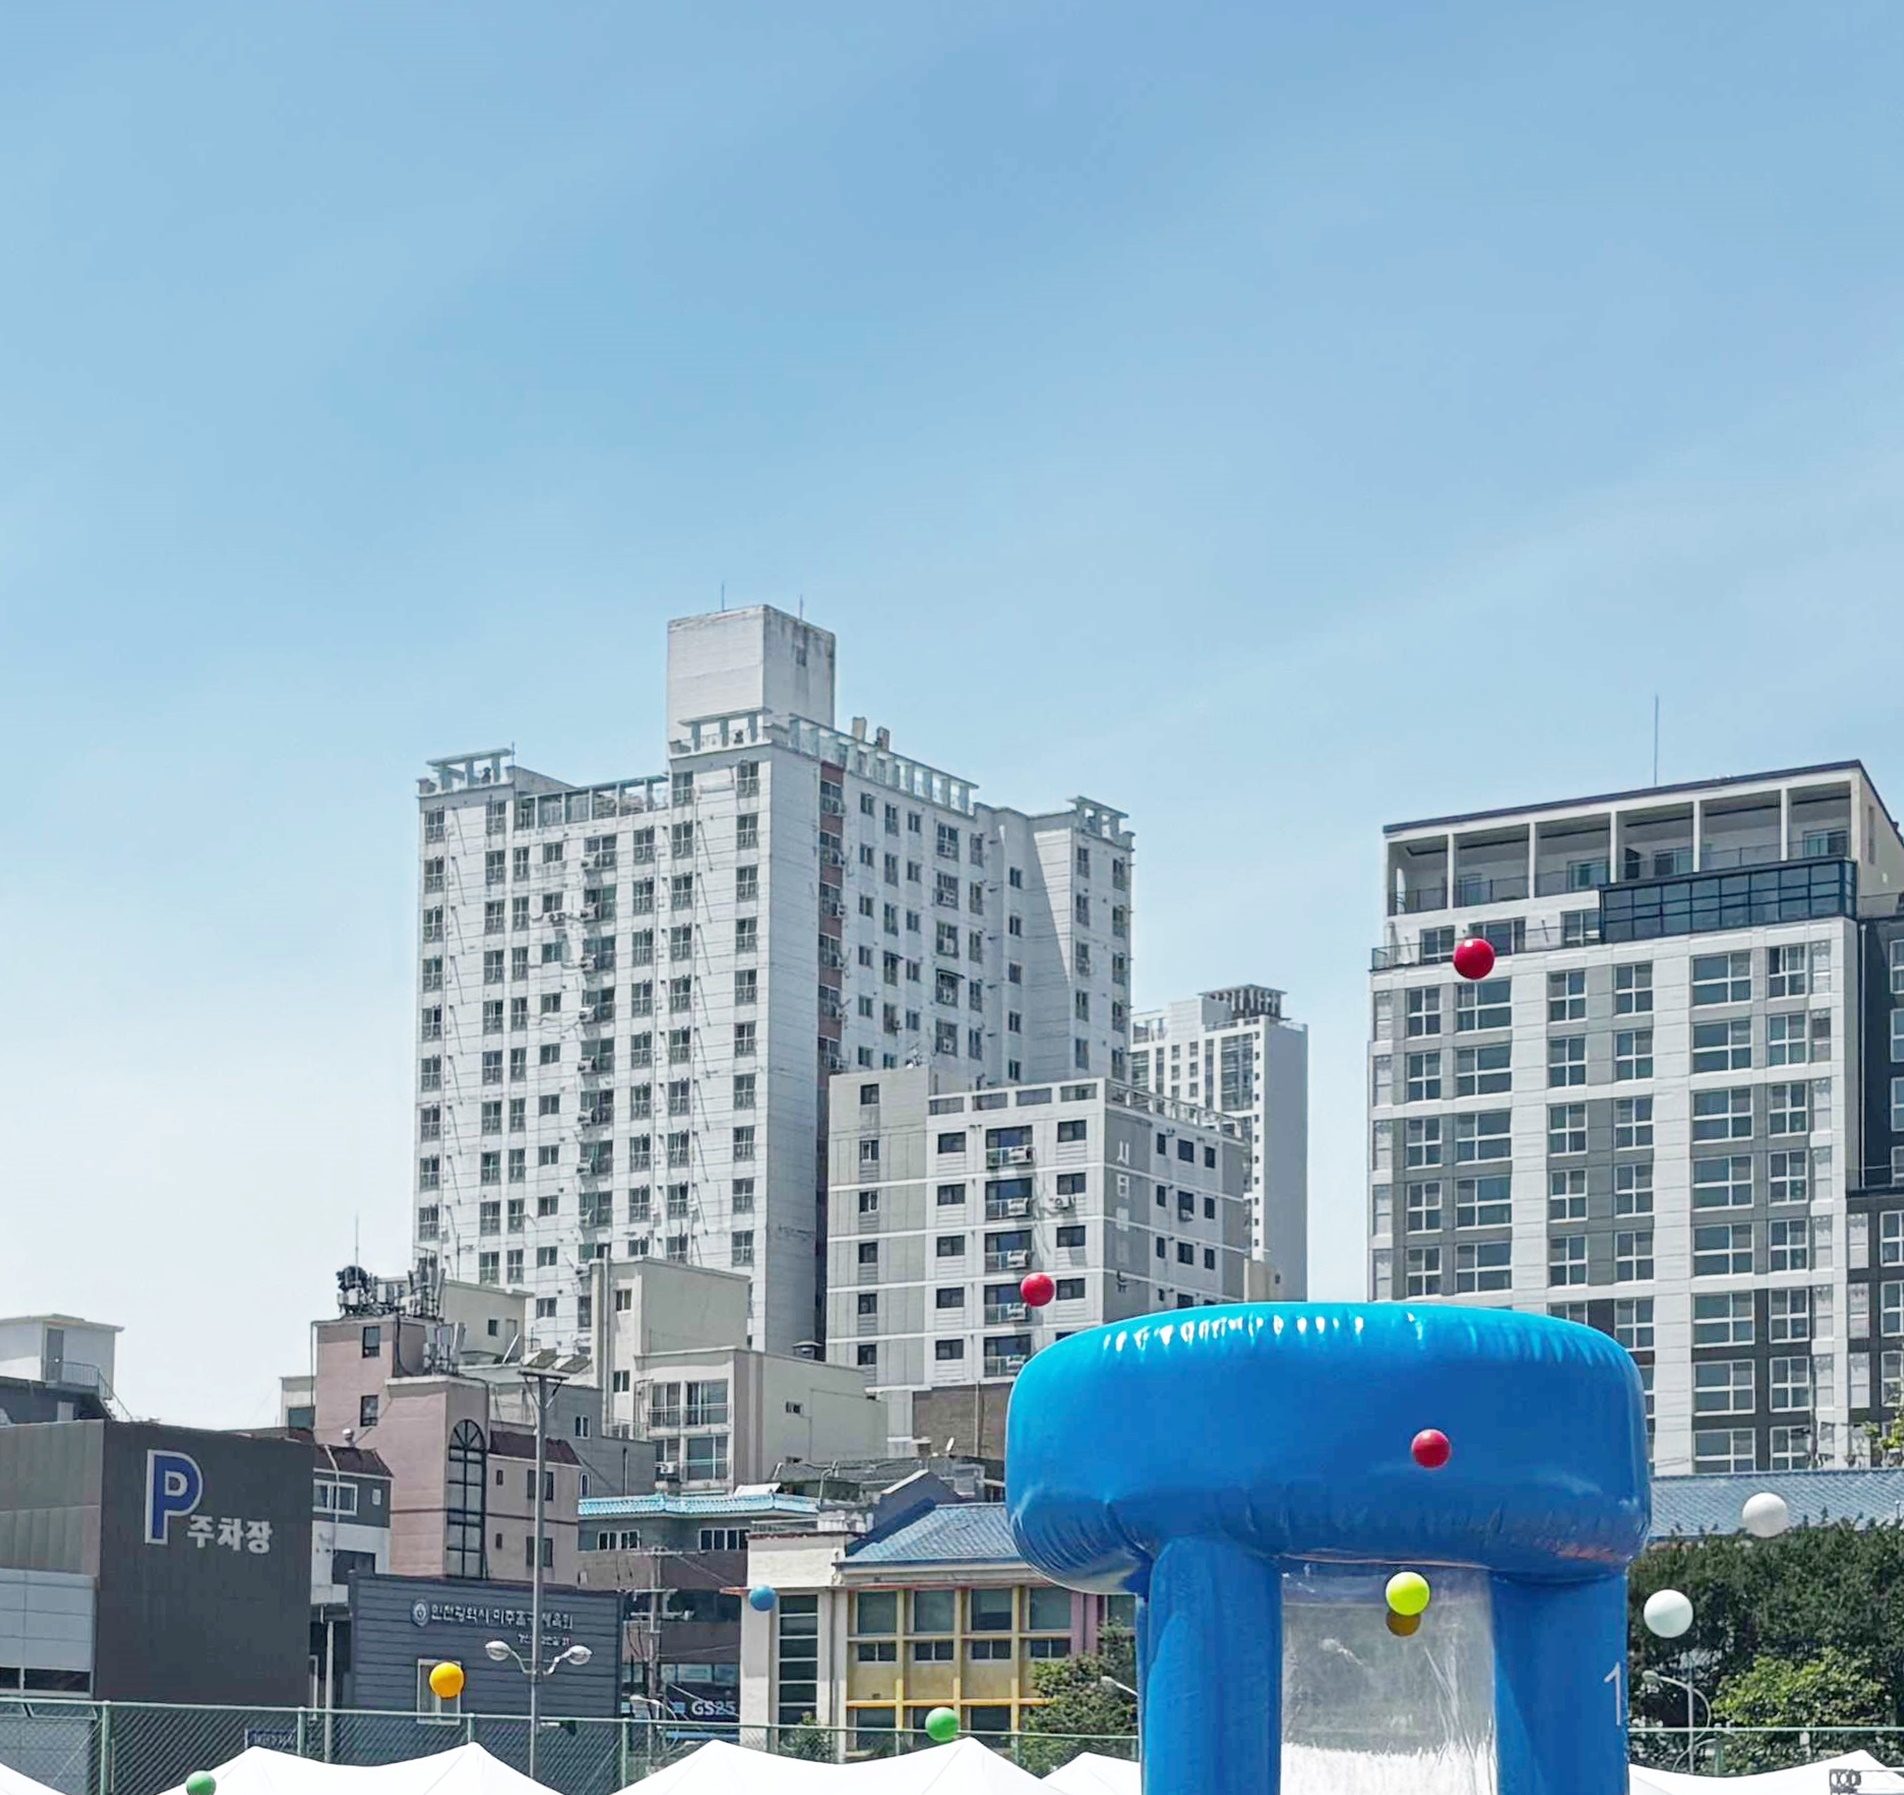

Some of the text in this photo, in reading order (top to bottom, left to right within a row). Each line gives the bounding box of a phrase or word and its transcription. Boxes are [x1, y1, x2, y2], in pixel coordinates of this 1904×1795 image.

[145, 1449, 203, 1545] P
[187, 1514, 273, 1554] 주차장
[431, 1603, 489, 1624] 인천광역시
[691, 1700, 737, 1716] GS25
